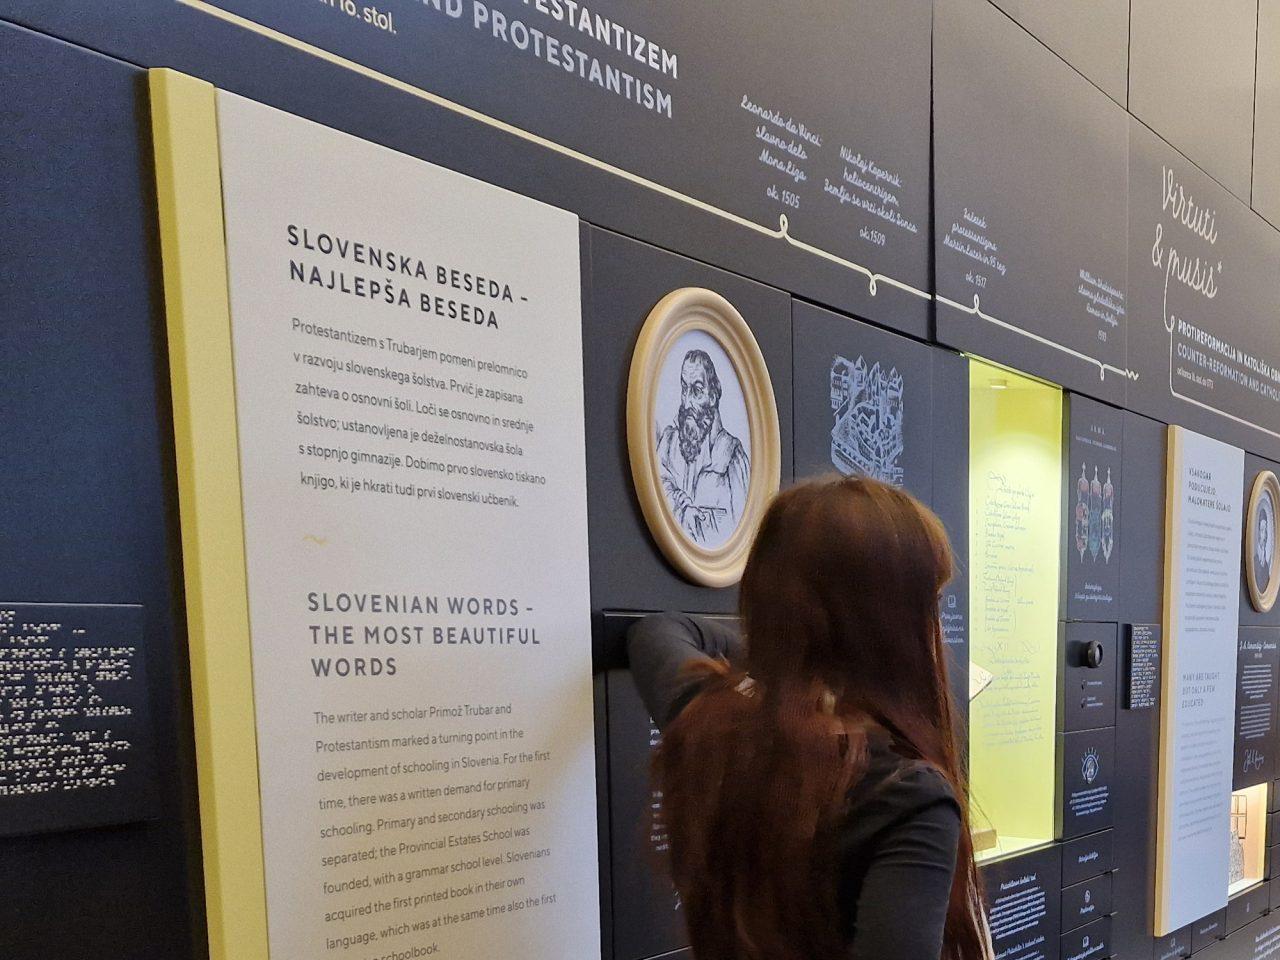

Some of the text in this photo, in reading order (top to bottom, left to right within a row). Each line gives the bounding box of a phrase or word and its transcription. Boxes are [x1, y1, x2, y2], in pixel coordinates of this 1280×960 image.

[363, 6, 397, 34] stol.
[474, 0, 673, 119] PROTESTANTISM
[741, 95, 785, 127] Leonardo
[786, 119, 798, 135] da
[759, 149, 786, 171] Mona
[787, 141, 807, 160] delo
[840, 145, 868, 173] Nikolaj
[781, 193, 800, 209] 1505
[1162, 165, 1218, 244] Virtuti
[870, 231, 886, 246] 1509
[1152, 223, 1164, 269] &
[287, 225, 513, 302] SLOVENSKA BESEDA
[290, 260, 499, 329] NAJLEPŠA BESEDA
[292, 318, 528, 379] Protestantizem s Trubarjem pomeni prelomnico
[1178, 319, 1236, 360] PROTIREFORMACIJA
[294, 352, 523, 404] v razvoju slovenskega šolstva. Prvič je zapisana
[1178, 343, 1248, 386] COUNTER-REFORMATION
[1248, 378, 1259, 392] AND
[296, 382, 534, 433] zahteva o osnovni šoli. Loči se osnovno in srednje
[297, 411, 523, 456] šolstvo; ustanovljena je deželnostanovska šola
[299, 445, 546, 485] s stopnjo gimnazije. Dobimo prvo slovensko tiskano
[301, 472, 519, 507] knjigo, ki je hkrati tudi prvi slovenski učbenik.
[307, 592, 519, 616] SLOVENIAN WORDS
[309, 626, 540, 644] THE MOST BEAUTIFUL
[311, 658, 397, 677] WORDS
[314, 704, 512, 724] The writer and scholar Primož Trubar and
[316, 728, 524, 752] Protestantism marked a turning point in the
[317, 764, 388, 782] development
[390, 760, 401, 774] of
[402, 758, 450, 774] schooling
[452, 756, 460, 769] in
[503, 752, 517, 764] For
[519, 752, 533, 762] the
[535, 750, 550, 762] first
[319, 777, 530, 811] time, there was a written demand for primary
[320, 800, 545, 839] schooling. Primary and secondary schooling was
[322, 827, 530, 867] separated; the Provincial Estates School was
[323, 876, 372, 895] founded,
[373, 872, 395, 886] with
[397, 872, 404, 882] a
[406, 864, 449, 884] grammar
[451, 857, 481, 873] school
[506, 847, 550, 863] Slovenians
[325, 876, 525, 923] acquired the first printed book in their own
[326, 893, 557, 950] language, which was at the same time also the first
